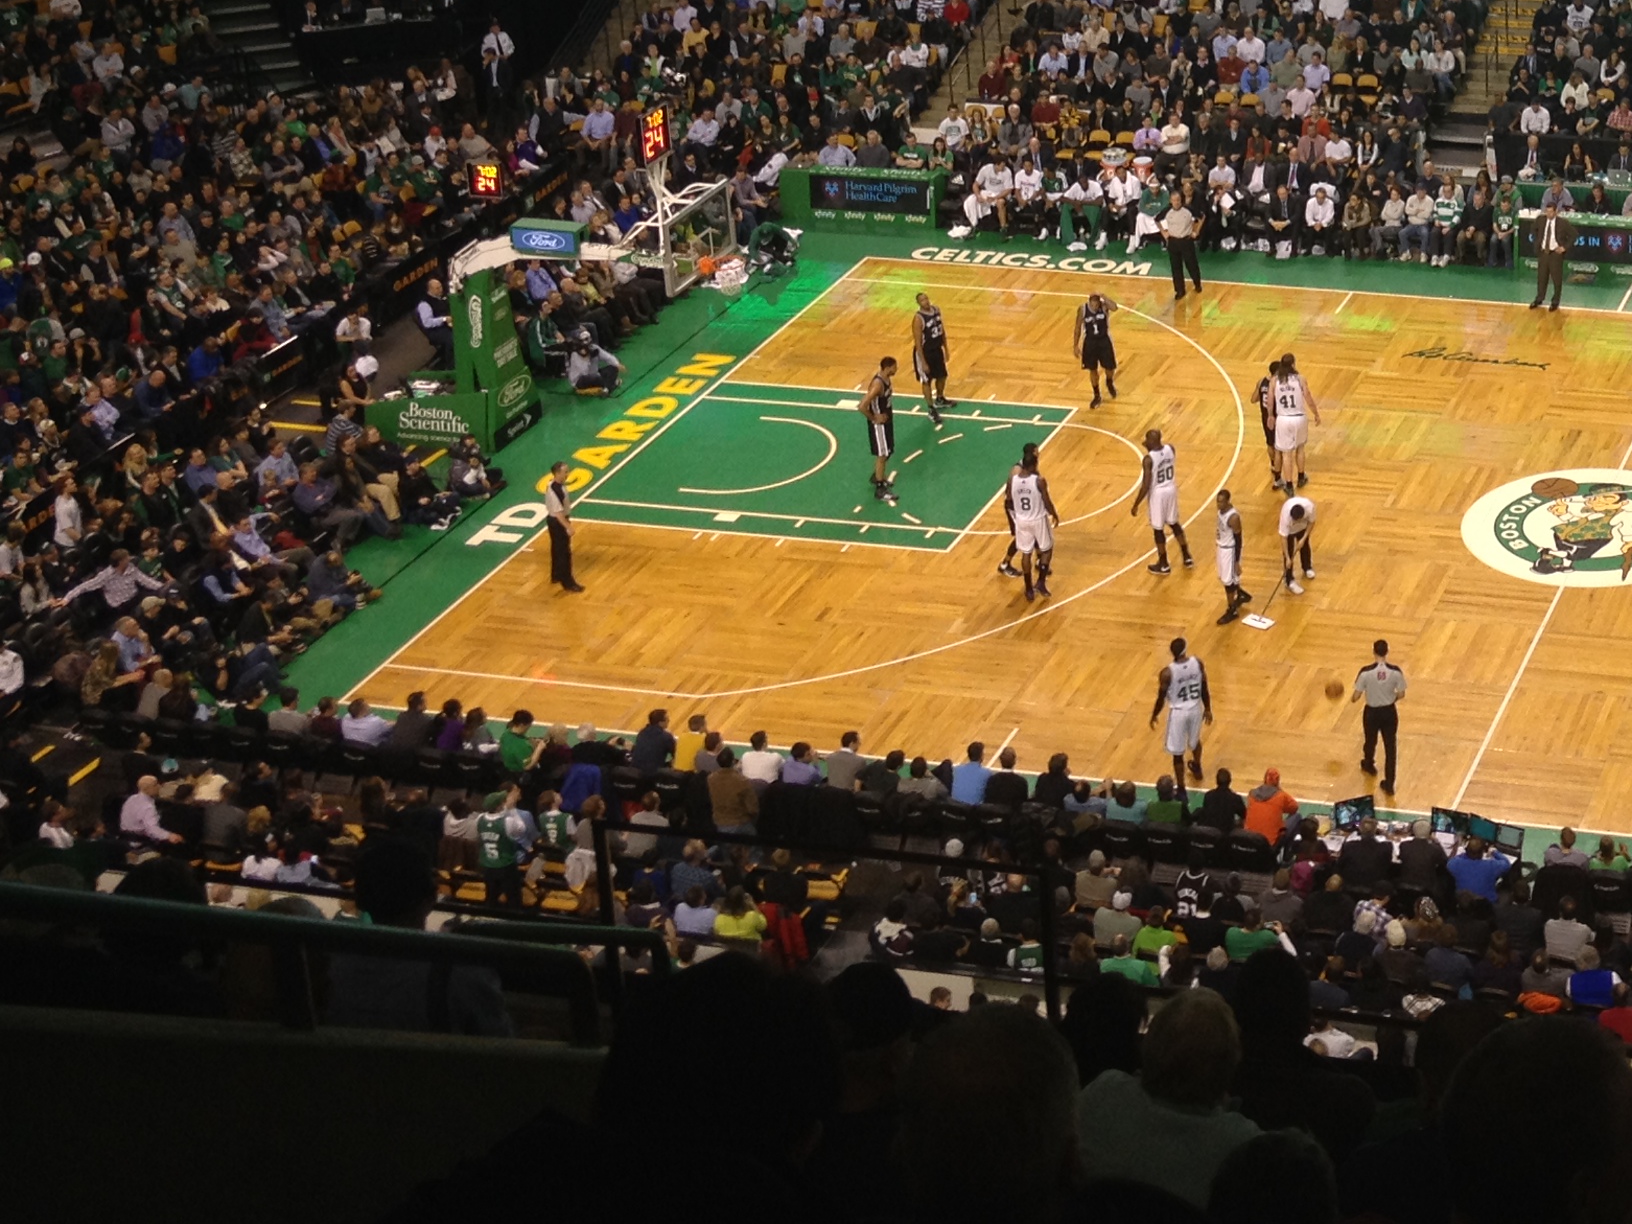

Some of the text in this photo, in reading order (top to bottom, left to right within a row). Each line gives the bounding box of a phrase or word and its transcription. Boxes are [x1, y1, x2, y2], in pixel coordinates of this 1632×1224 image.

[647, 109, 664, 128] 7:02
[645, 126, 664, 158] 24
[477, 165, 498, 178] 7:02
[477, 178, 495, 191] 24
[845, 181, 917, 195] Harvard Pilgrim
[528, 232, 558, 248] Ford
[1588, 237, 1600, 247] IN
[911, 247, 1152, 275] CELTICS.COM
[393, 256, 439, 292] GARDEN
[1279, 394, 1296, 408] 41
[409, 402, 453, 420] Boston
[399, 411, 469, 434] Scientific
[465, 353, 736, 546] TD GARDEN
[1157, 465, 1174, 484] 50
[1020, 497, 1031, 511] 8
[1499, 496, 1543, 551] BOSTON
[1178, 683, 1200, 702] 45
